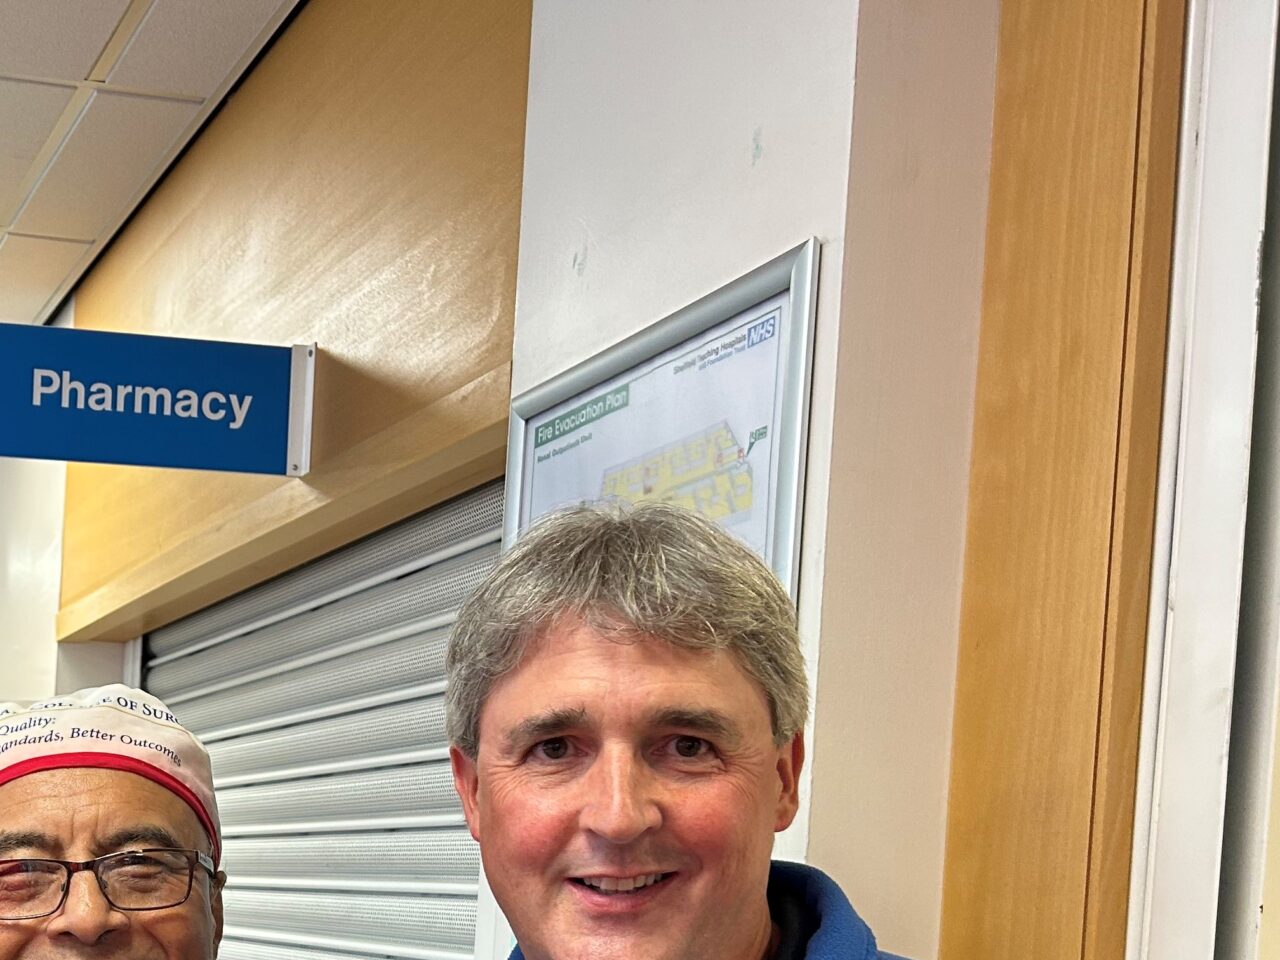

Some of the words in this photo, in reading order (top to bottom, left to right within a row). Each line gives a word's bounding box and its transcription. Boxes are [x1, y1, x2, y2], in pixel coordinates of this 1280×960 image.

[720, 333, 746, 351] Hospitals
[749, 318, 774, 346] NHS
[32, 368, 252, 429] Pharmacy
[537, 426, 553, 444] Fire
[555, 402, 604, 436] Evacuation
[605, 390, 627, 411] Plan
[117, 696, 138, 710] OF
[70, 727, 117, 742] Better
[120, 734, 181, 767] Outcomes
